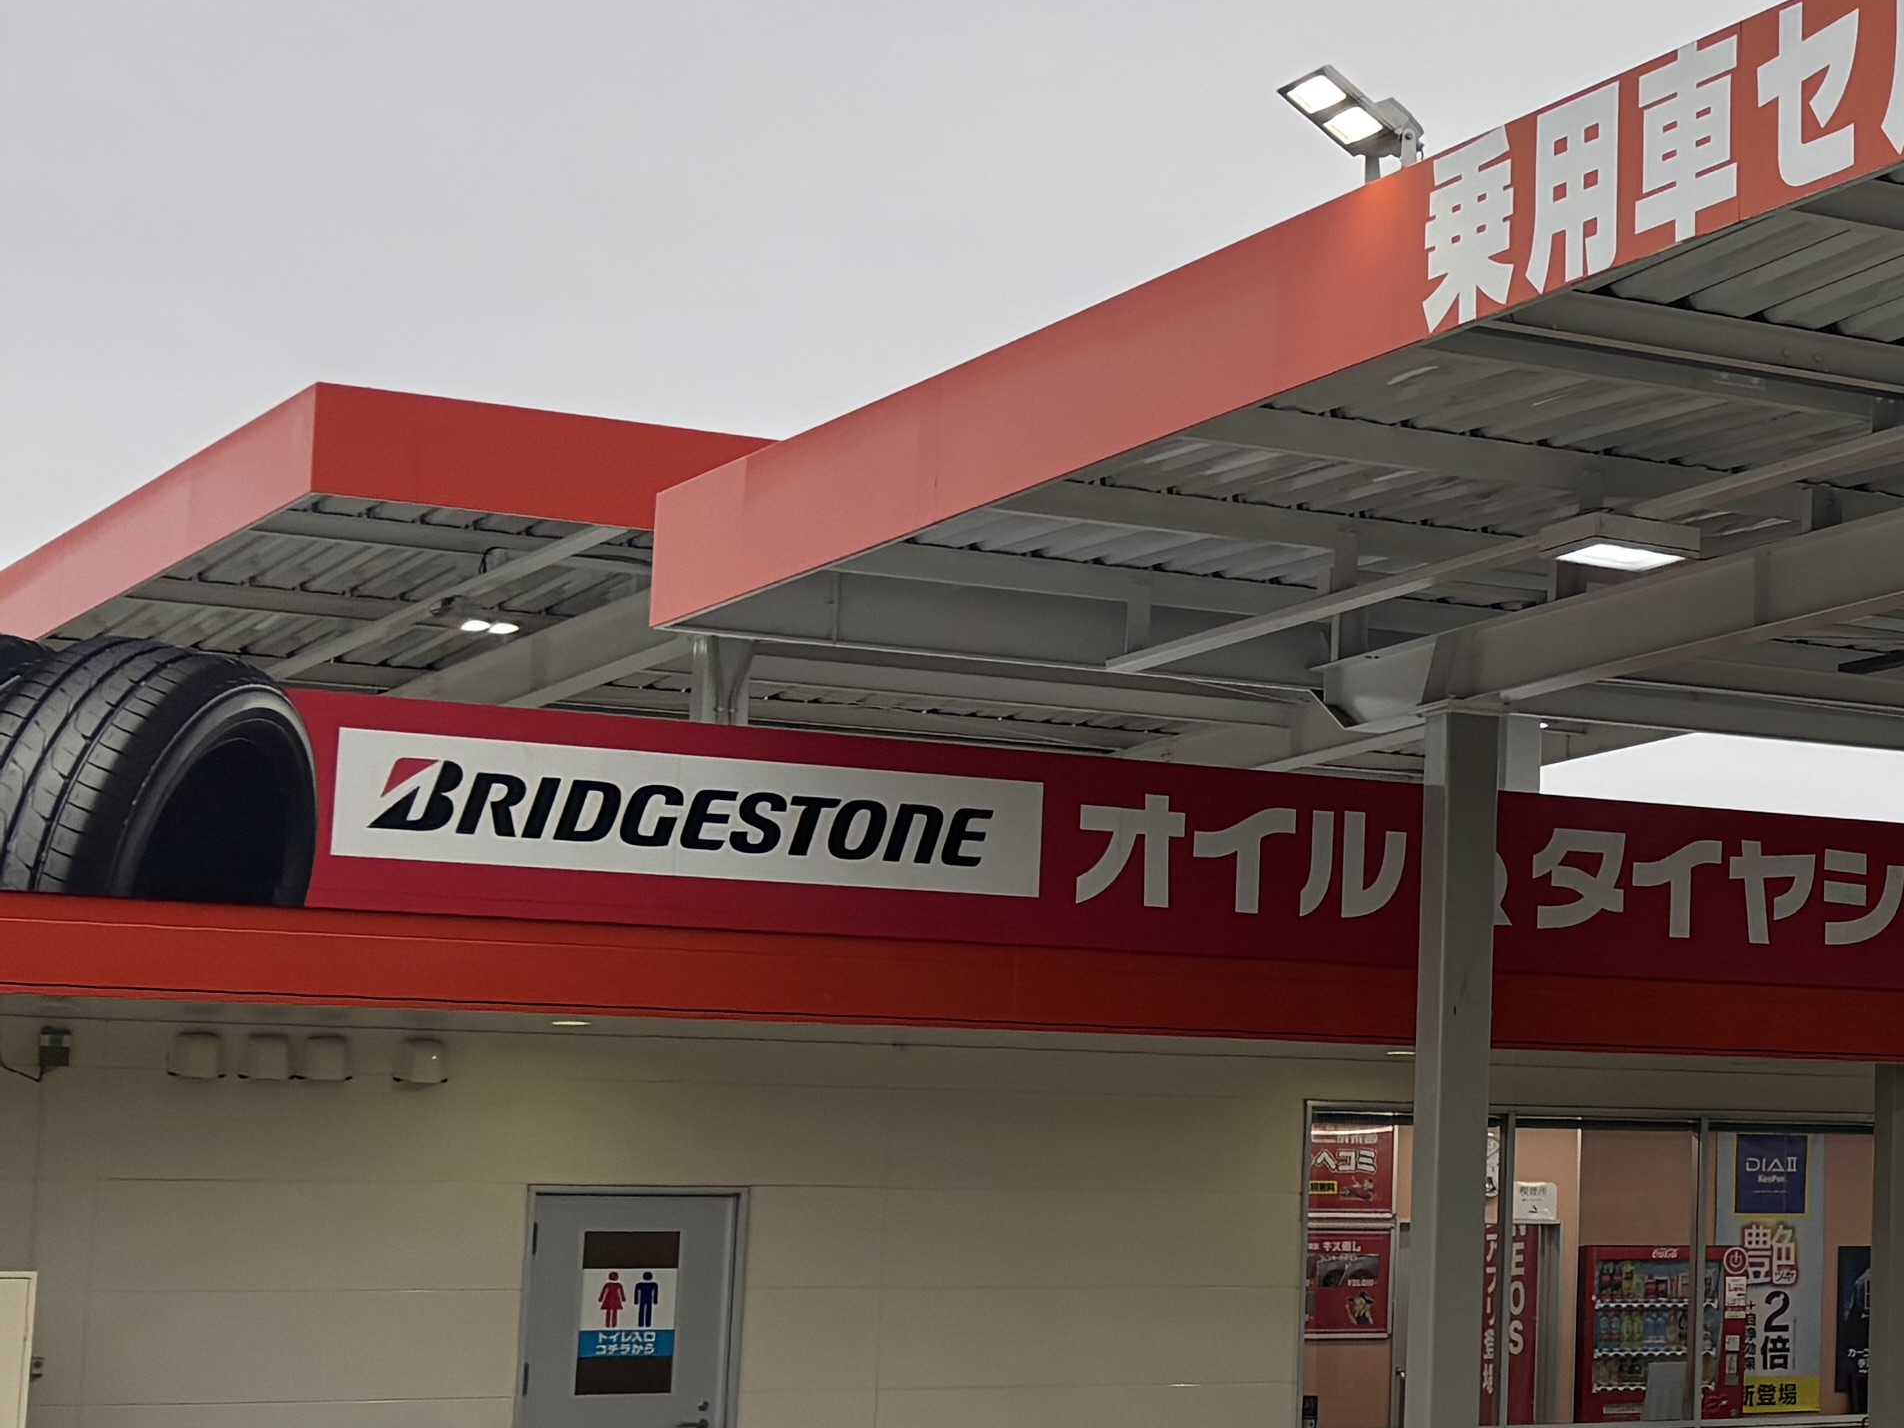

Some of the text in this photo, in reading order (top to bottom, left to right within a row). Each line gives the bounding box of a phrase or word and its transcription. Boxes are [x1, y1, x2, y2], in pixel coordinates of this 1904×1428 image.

[368, 756, 994, 866] BRIDGESTONE
[598, 1331, 656, 1343] トイレ入口
